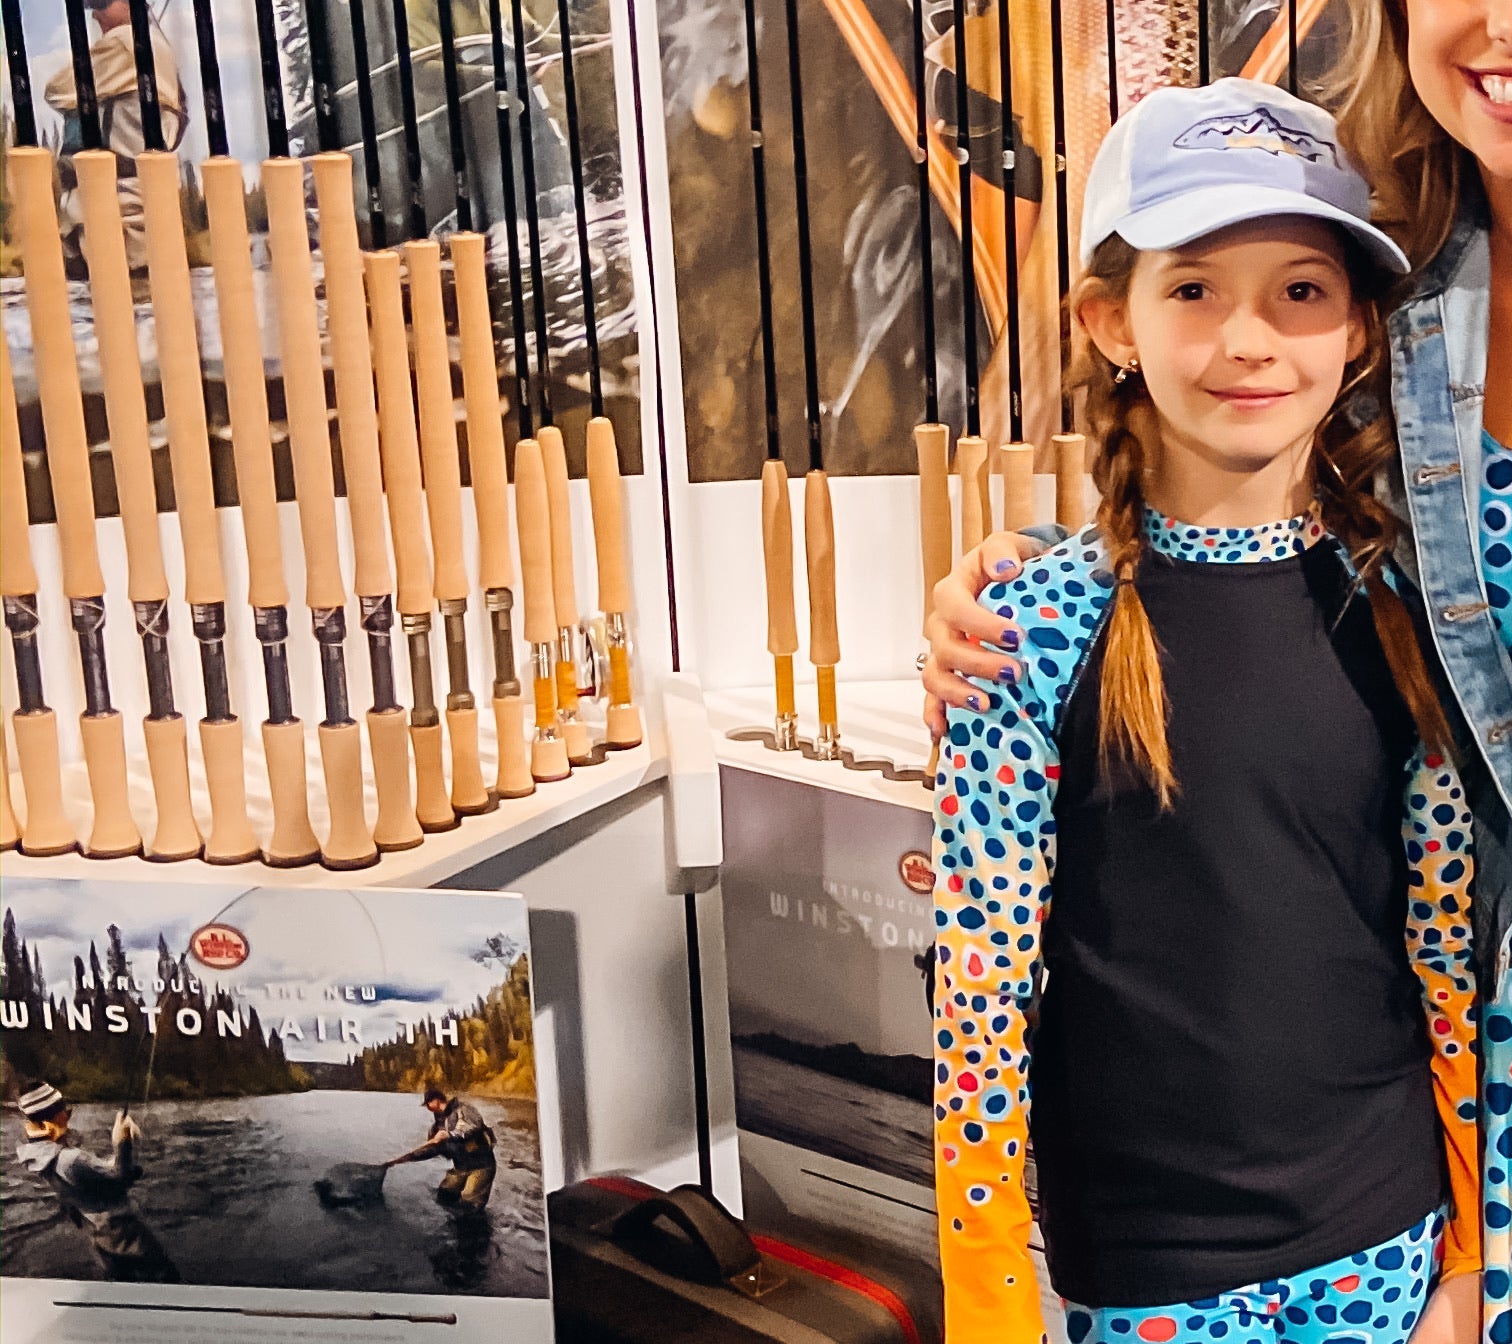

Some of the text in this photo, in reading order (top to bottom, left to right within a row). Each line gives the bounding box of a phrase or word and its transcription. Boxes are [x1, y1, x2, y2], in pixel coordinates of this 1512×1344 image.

[770, 890, 925, 950] WINSTON
[324, 984, 377, 1002] NEW
[0, 999, 459, 1047] WINSTON AIR TH
